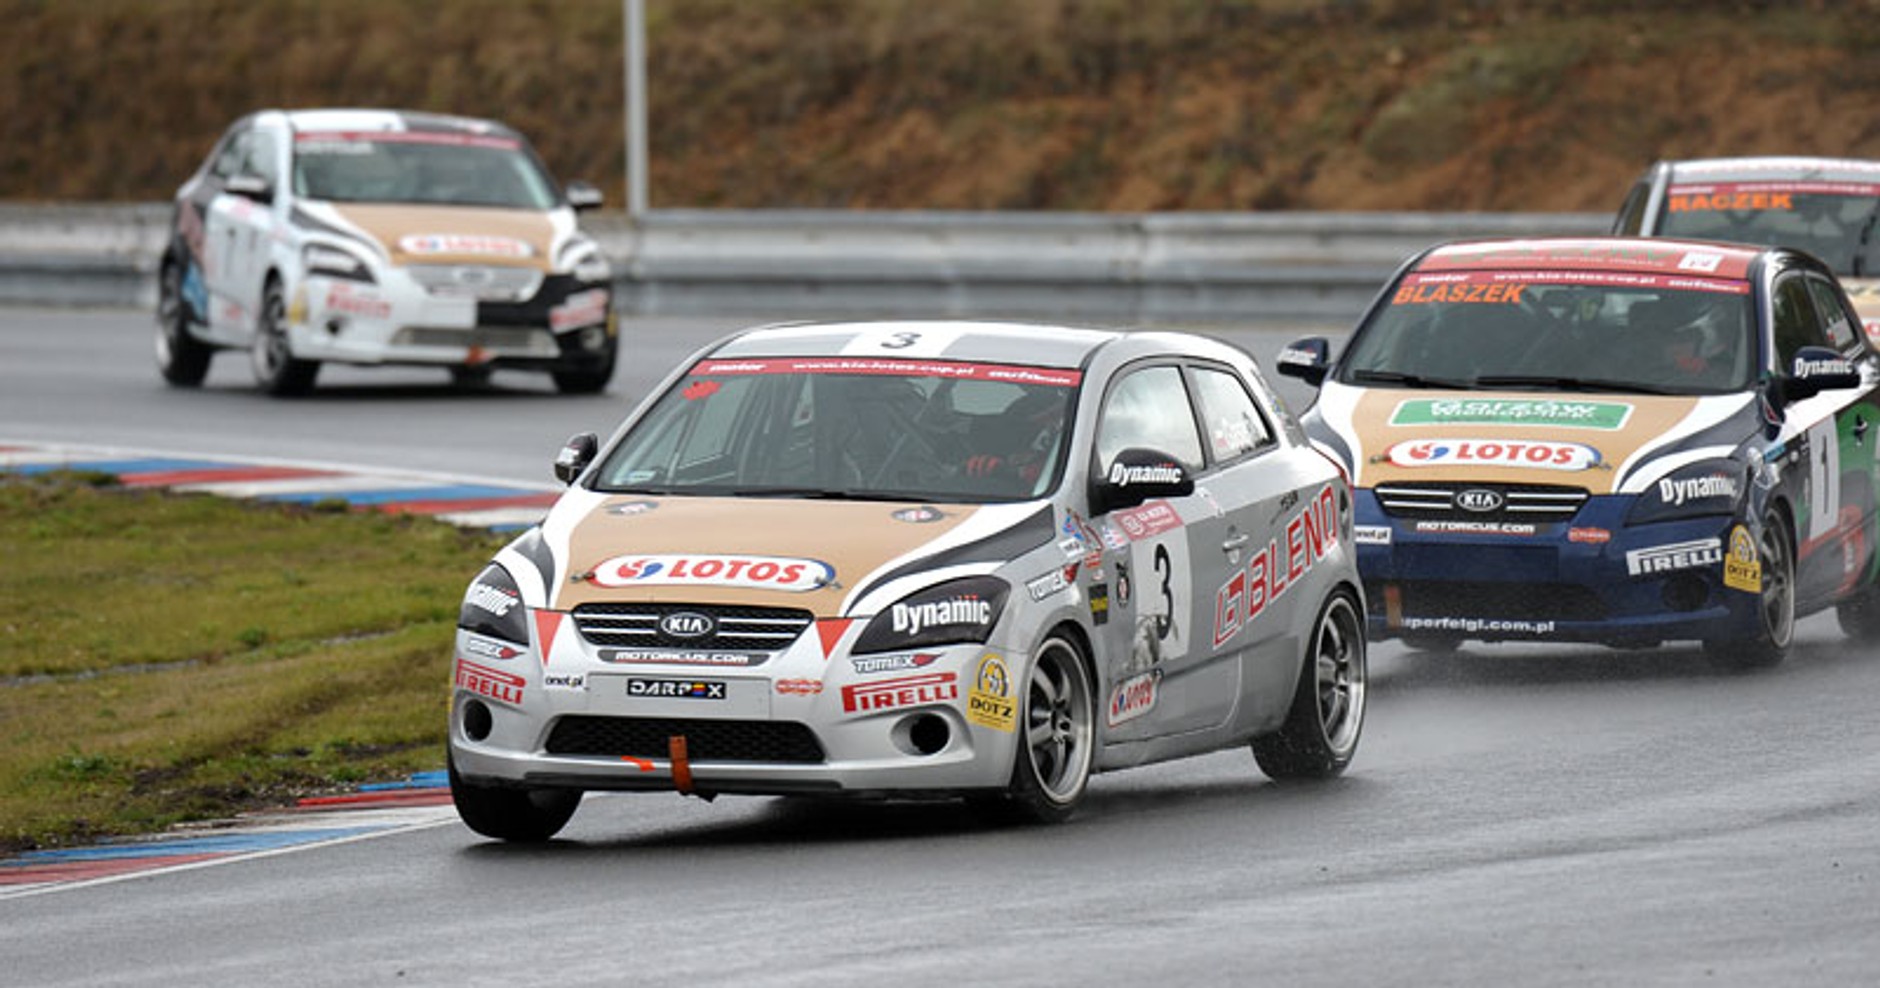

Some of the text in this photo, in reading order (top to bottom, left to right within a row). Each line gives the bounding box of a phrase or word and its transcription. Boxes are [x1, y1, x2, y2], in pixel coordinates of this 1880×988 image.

[1668, 192, 1795, 213] RACZEK
[1392, 284, 1528, 305] BLASZEK
[880, 332, 923, 349] 3
[1794, 357, 1852, 379] Dynamic
[1455, 443, 1576, 464] LOTOS
[1109, 462, 1182, 488] Dynamic
[1462, 493, 1496, 507] KIA
[1626, 537, 1722, 576] PIRELLI
[668, 559, 806, 583] LOTOS
[1154, 542, 1174, 639] 3
[668, 617, 704, 633] KIA
[892, 594, 990, 637] Dynamic
[456, 658, 527, 705] PIRELLI
[545, 675, 584, 688] onet.pl
[841, 672, 958, 714] PIRELLI
[970, 696, 1013, 718] DOTZ
